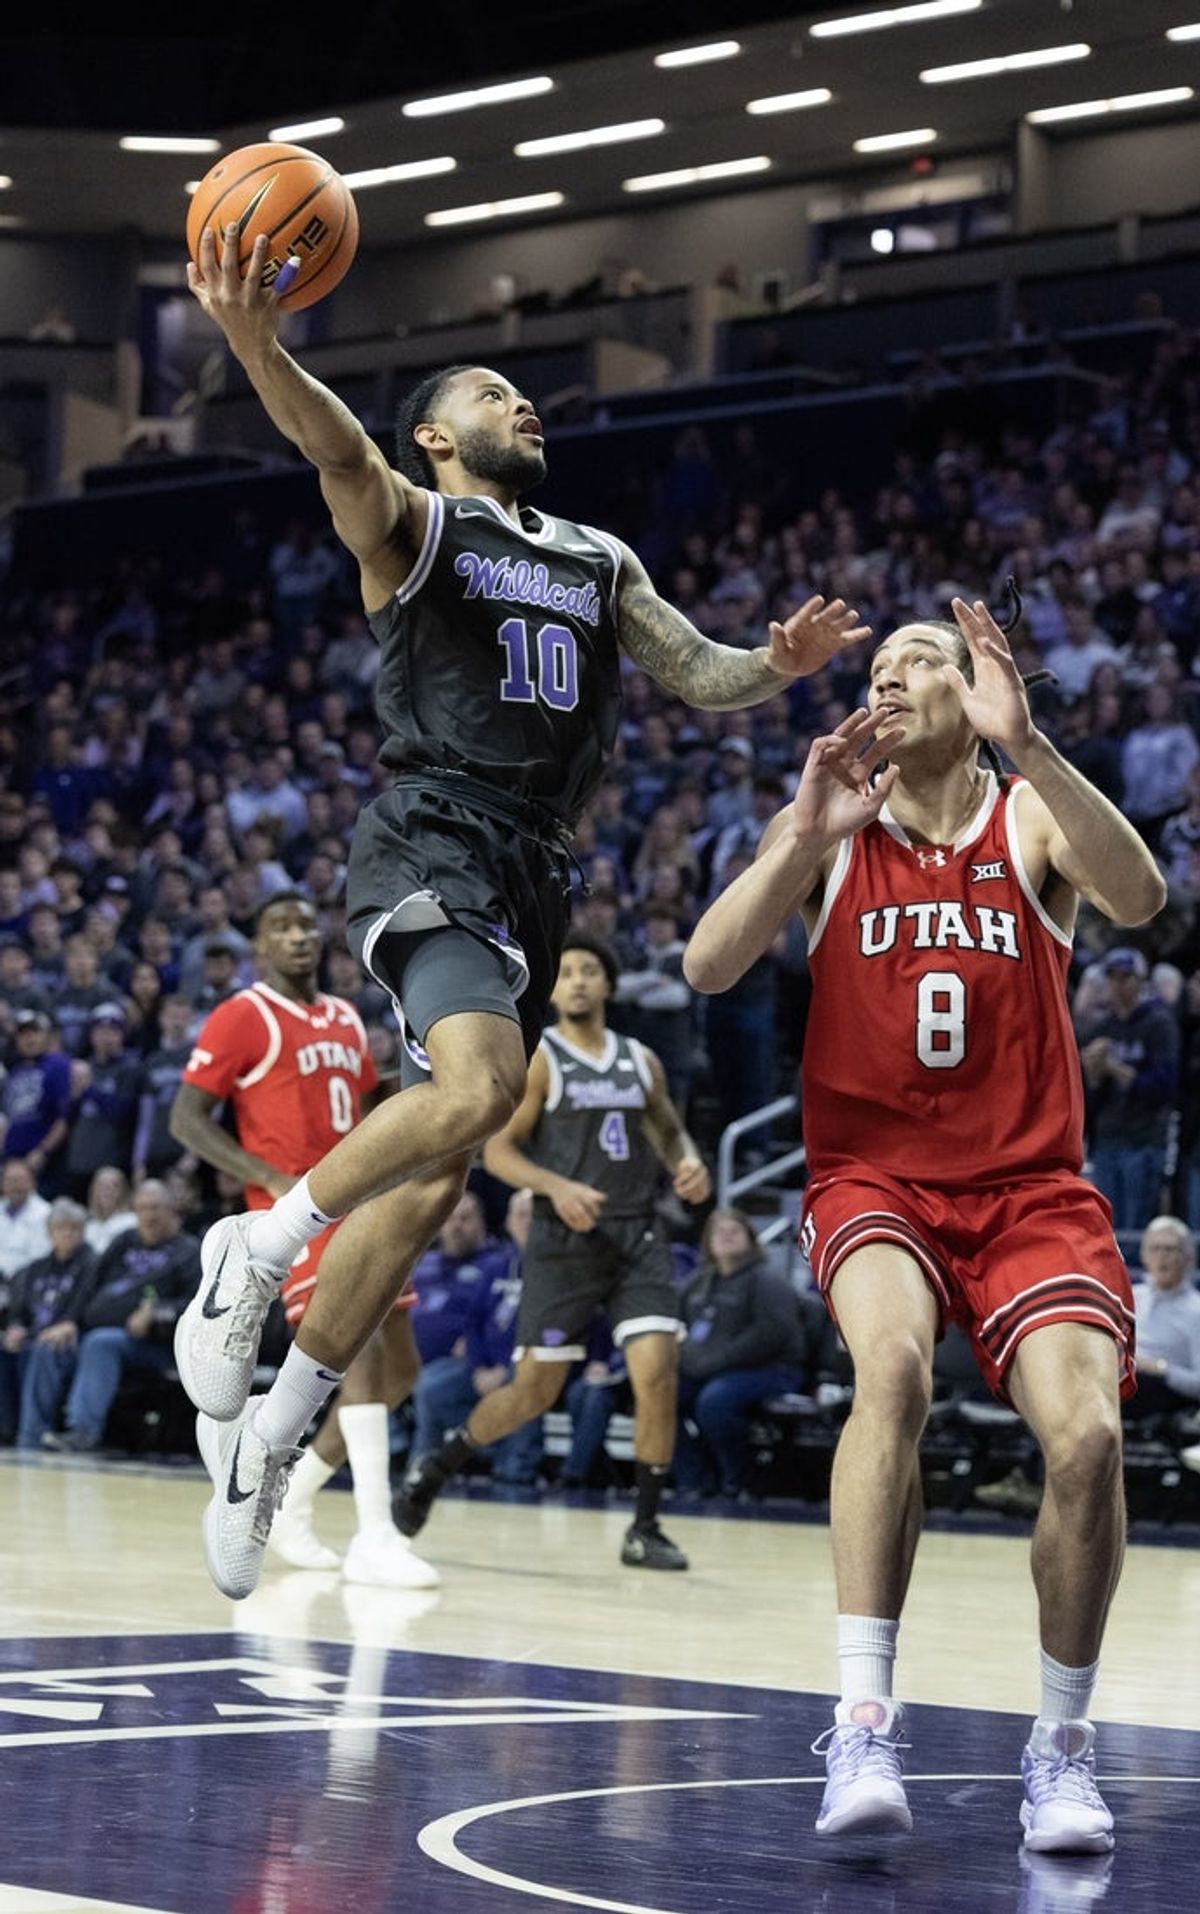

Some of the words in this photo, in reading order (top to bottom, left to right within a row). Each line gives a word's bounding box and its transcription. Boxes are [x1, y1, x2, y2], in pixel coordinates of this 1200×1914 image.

[498, 618, 579, 712] 10
[859, 901, 1021, 959] UTAH
[916, 970, 967, 1070] 8
[327, 1075, 353, 1134] 0
[598, 1110, 630, 1161] 4
